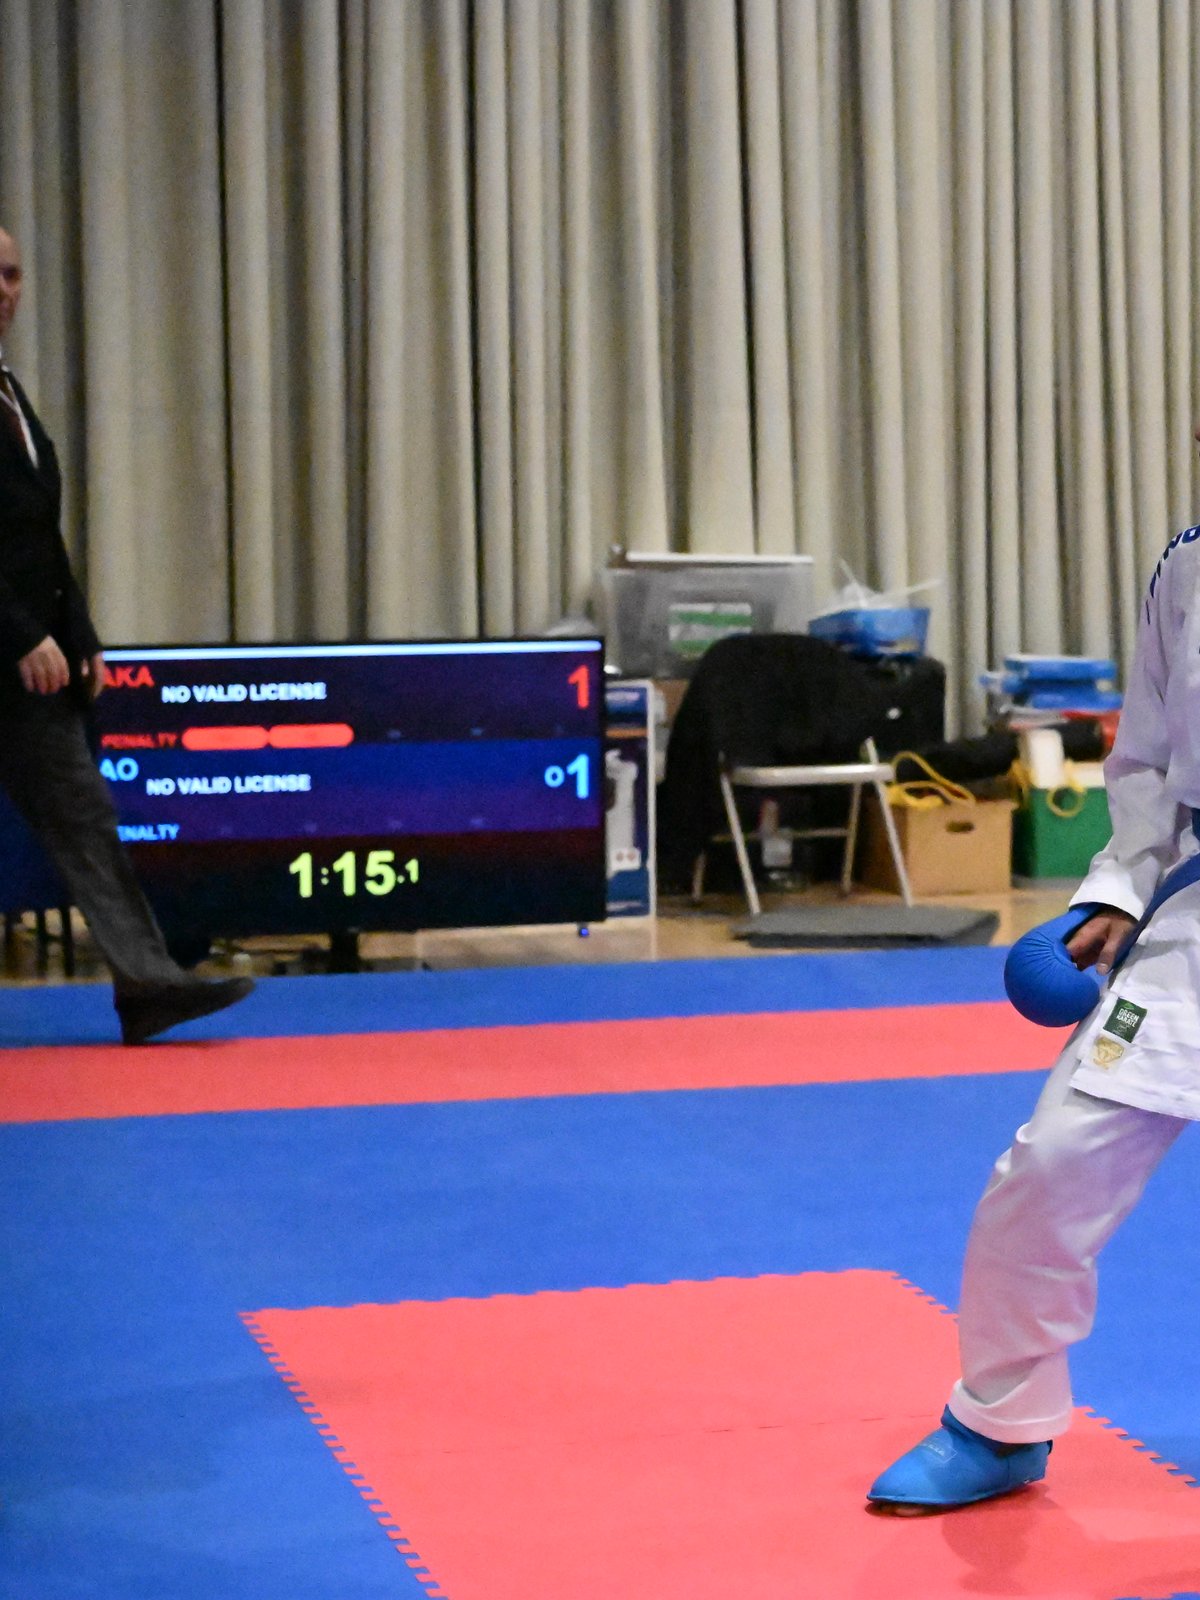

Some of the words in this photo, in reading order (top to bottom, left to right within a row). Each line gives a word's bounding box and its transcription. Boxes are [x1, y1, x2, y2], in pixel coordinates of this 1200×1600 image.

[102, 665, 155, 688] AKA
[567, 664, 590, 709] 1
[161, 686, 191, 703] NO
[193, 684, 248, 702] VALID
[250, 682, 327, 701] LICENSE
[100, 757, 140, 782] AO
[146, 778, 176, 796] NO
[177, 776, 232, 795] VALID
[234, 773, 312, 793] LICENSE
[117, 823, 180, 842] ENALTY
[1116, 1014, 1137, 1028] KARATE
[1118, 1008, 1140, 1022] GREEN
